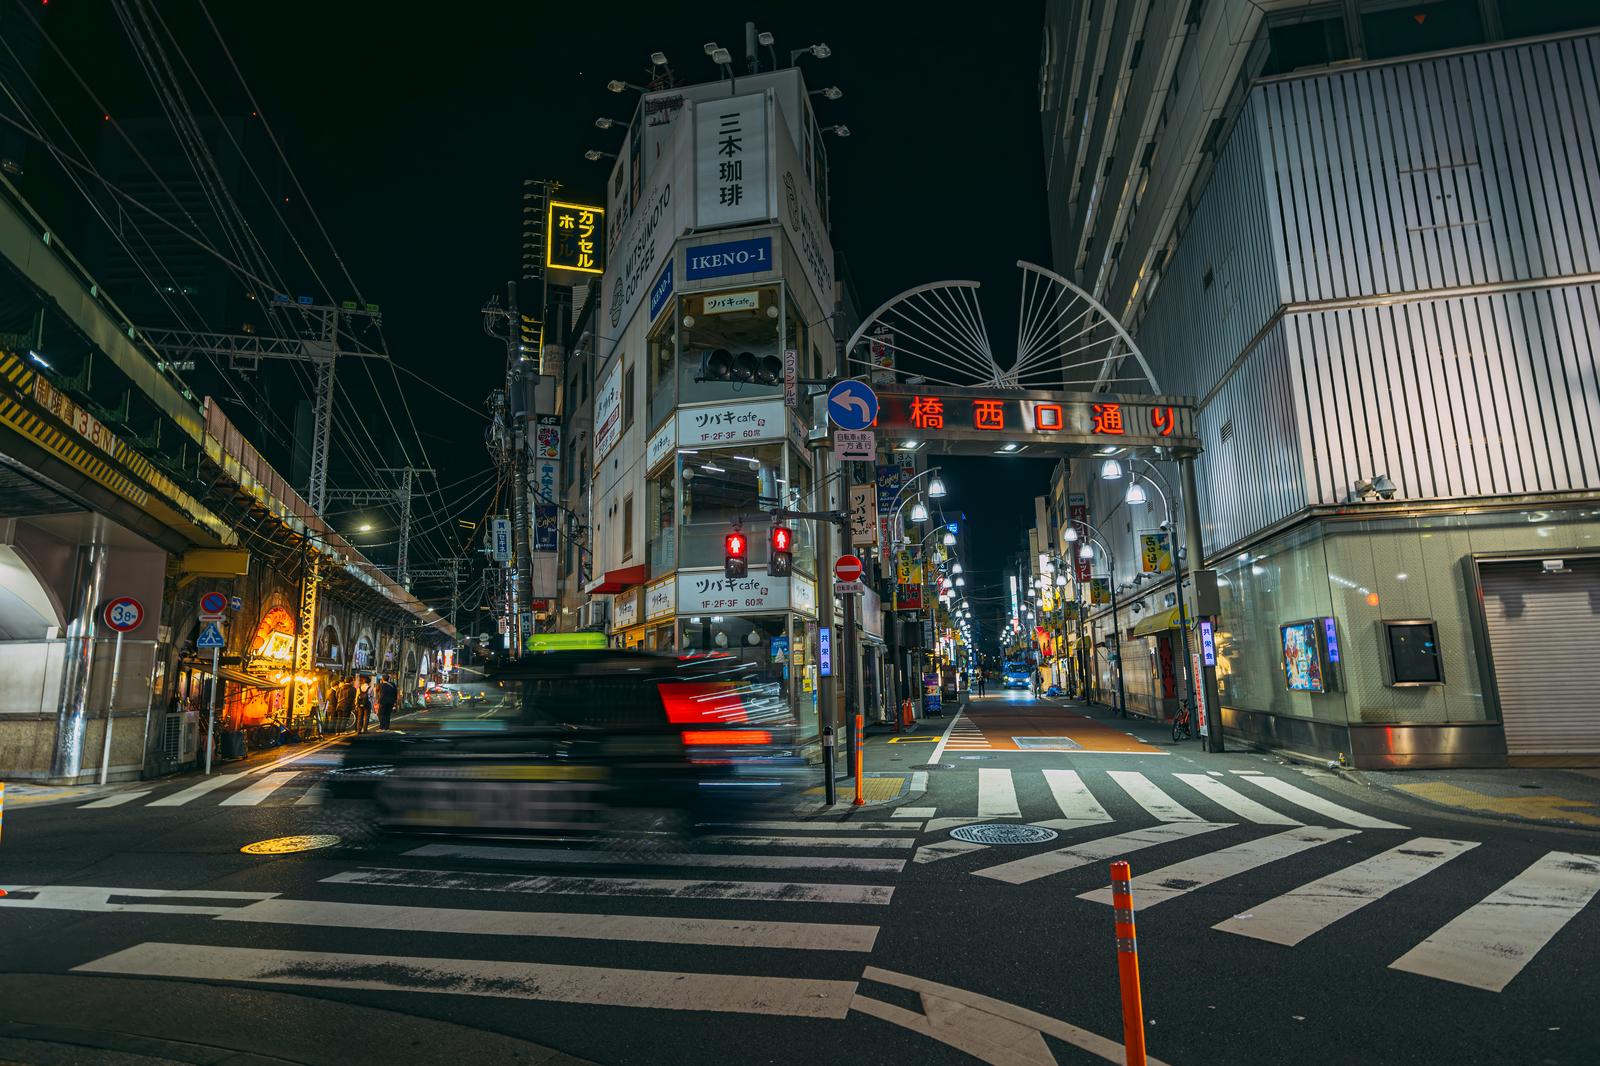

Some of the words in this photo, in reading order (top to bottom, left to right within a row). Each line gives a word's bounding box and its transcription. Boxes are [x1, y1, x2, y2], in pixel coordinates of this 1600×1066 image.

[718, 112, 742, 207] 三本珈琲
[577, 210, 595, 268] カプセル
[626, 184, 671, 281] MITSUMOTO
[625, 239, 656, 304] COFFEE
[691, 247, 766, 270] IKENO-1
[695, 410, 758, 428] ツバキcafe
[873, 395, 1177, 437] 橋西口通り
[855, 494, 867, 526] ツバキ
[695, 577, 761, 594] ツバキcafe
[820, 634, 830, 669] 共栄会
[1203, 628, 1214, 661] 共栄会
